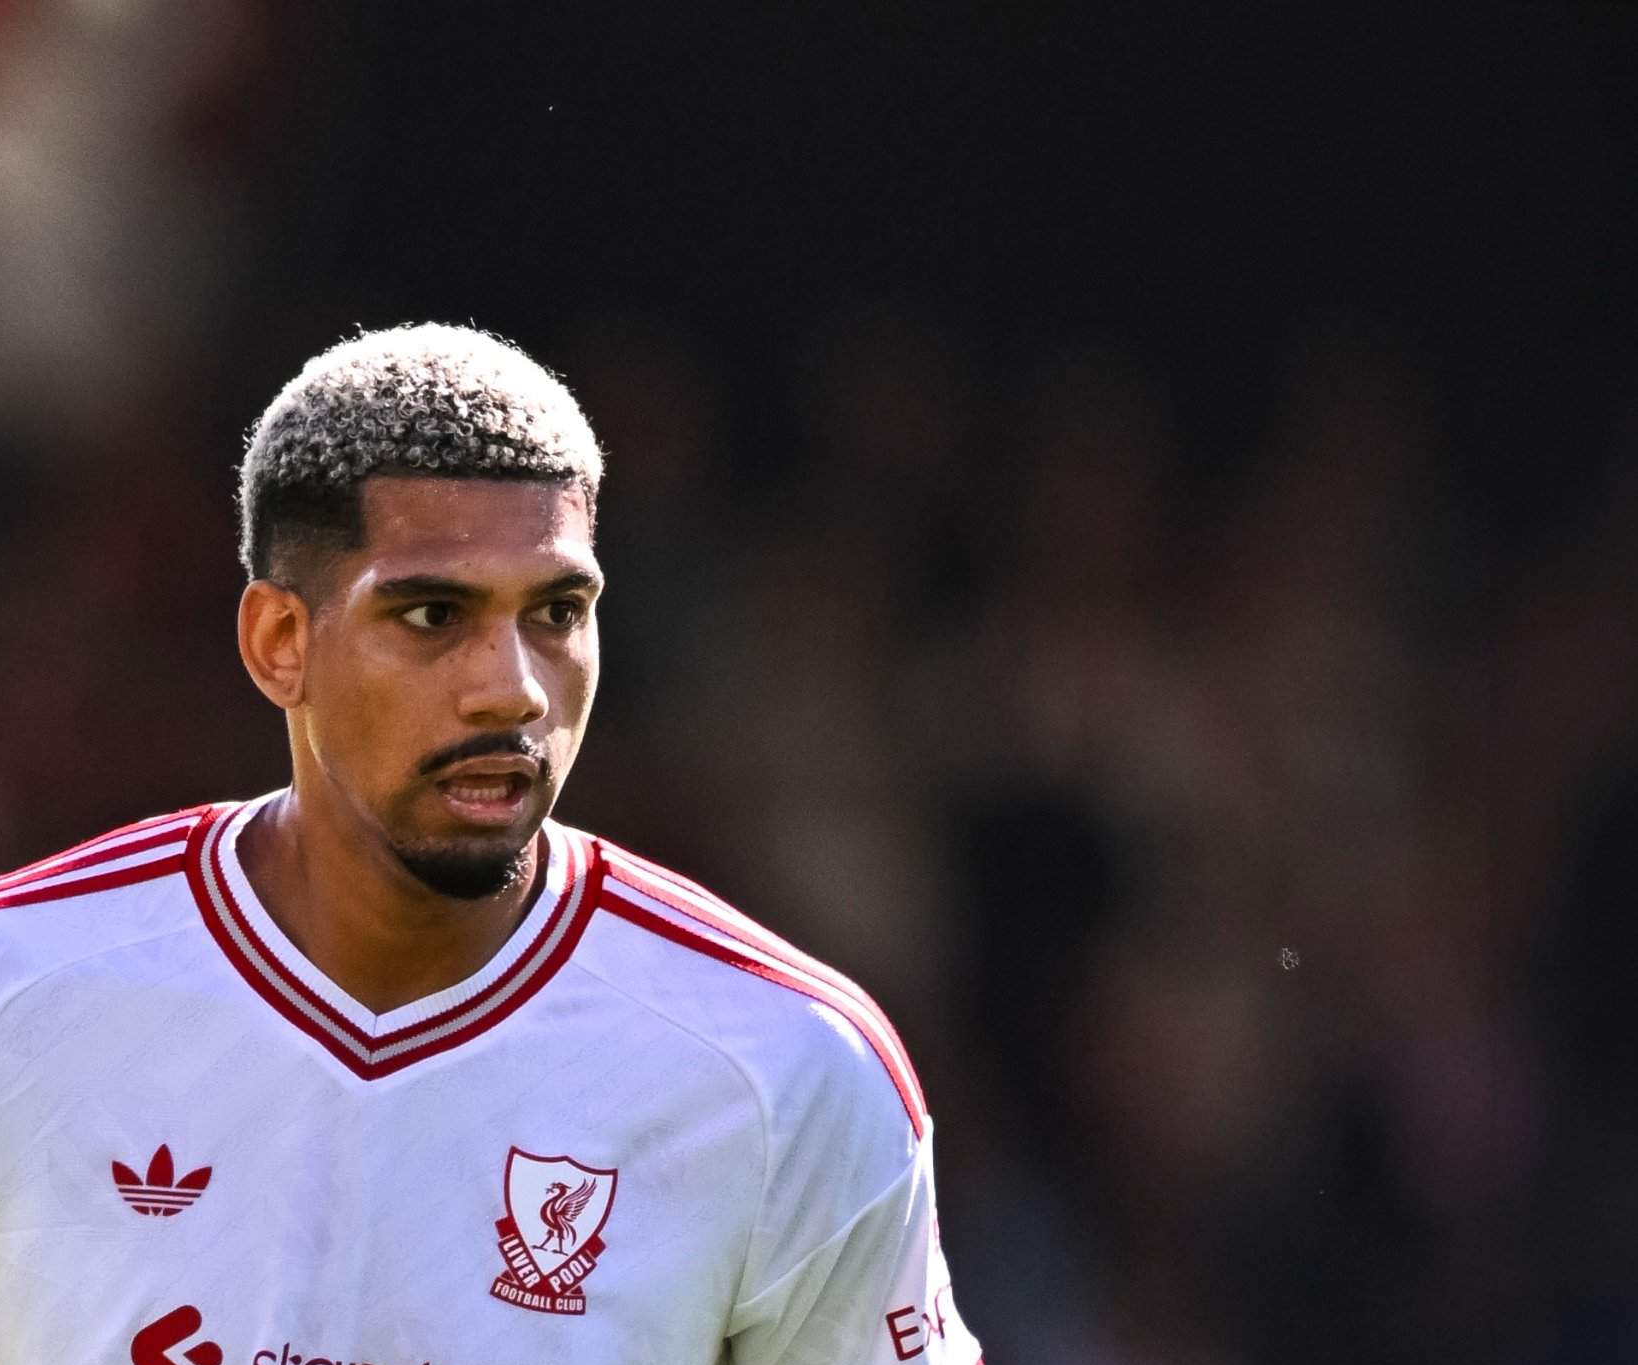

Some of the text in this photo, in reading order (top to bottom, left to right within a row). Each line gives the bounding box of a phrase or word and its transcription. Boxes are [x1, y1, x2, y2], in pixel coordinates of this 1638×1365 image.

[503, 1238, 593, 1293] LIVER POOL
[494, 1282, 583, 1311] FOOTBALL CLUB
